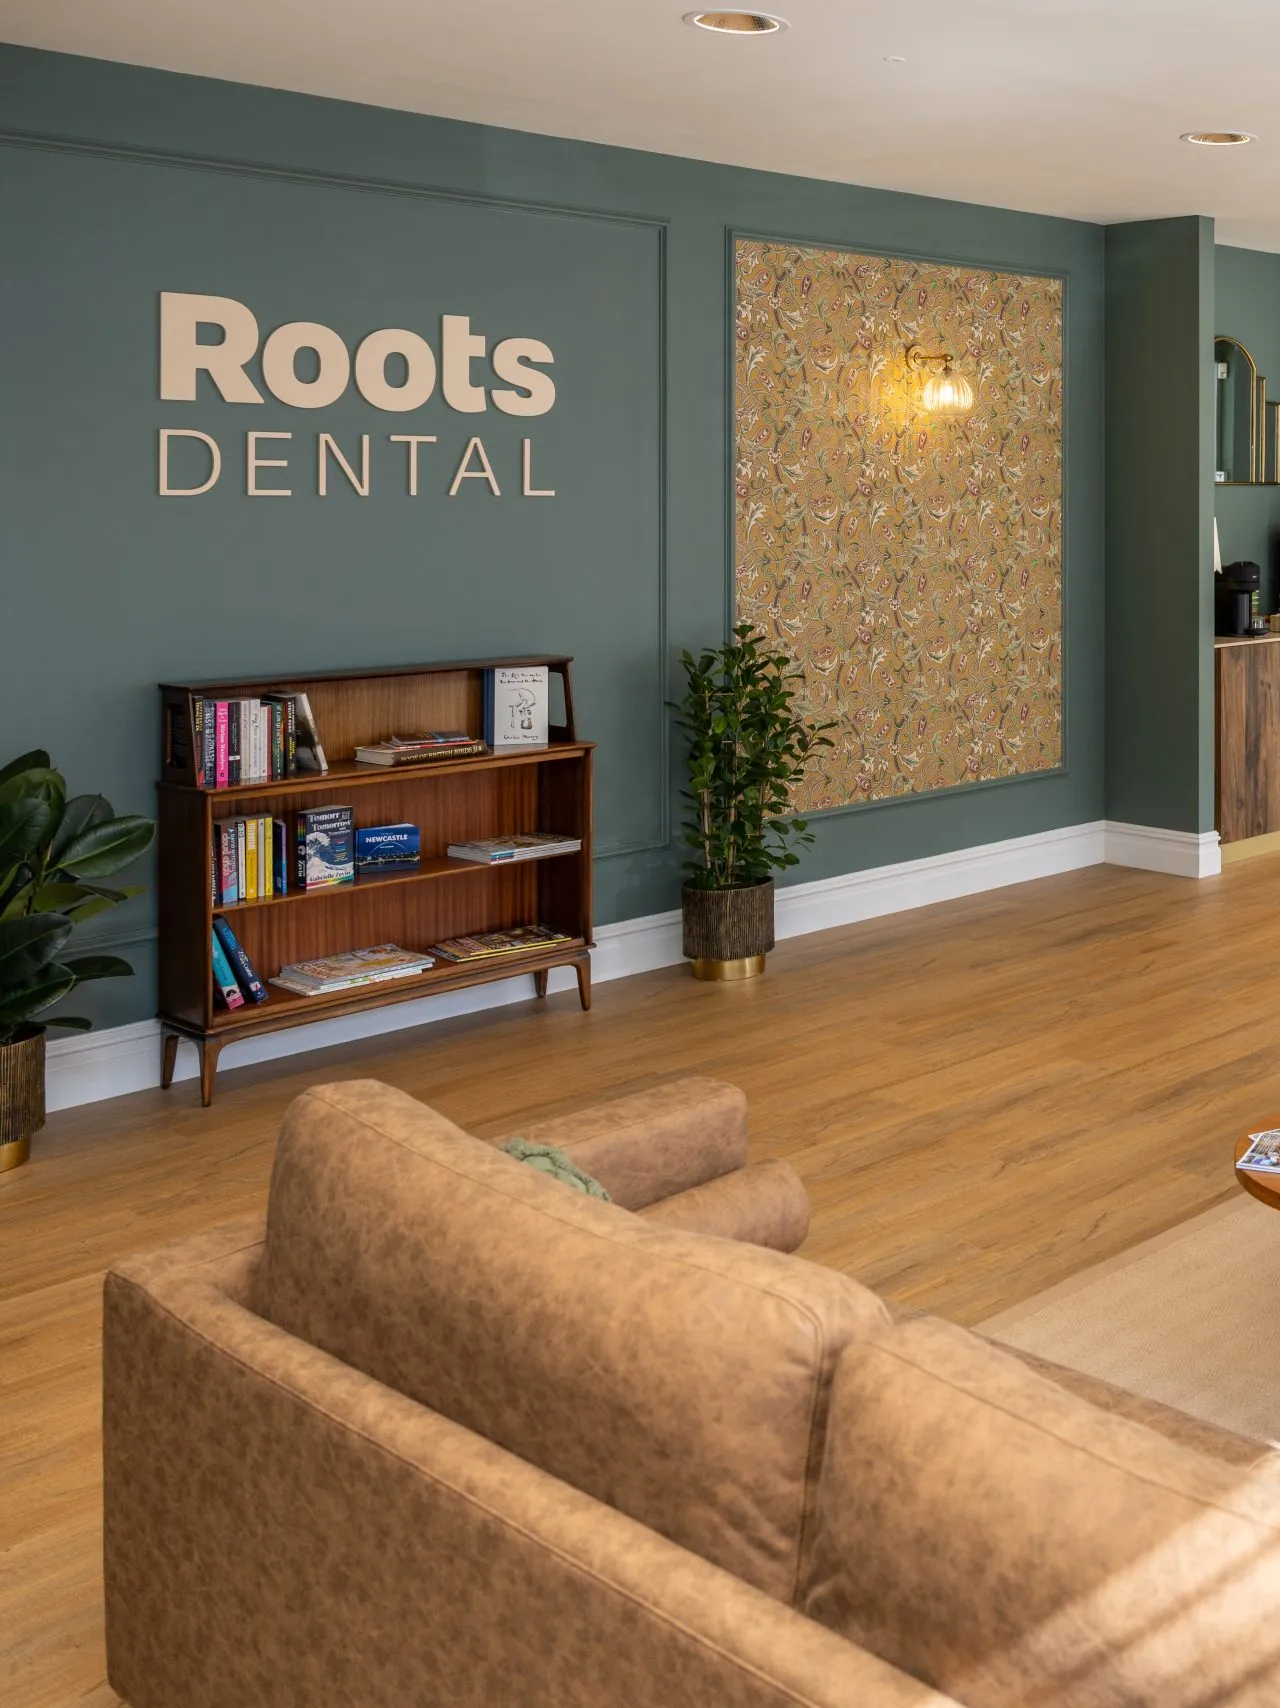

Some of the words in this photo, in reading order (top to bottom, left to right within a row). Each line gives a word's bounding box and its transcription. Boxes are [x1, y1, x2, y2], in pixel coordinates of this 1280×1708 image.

[158, 290, 556, 417] Roots
[157, 428, 556, 496] DENTAL
[454, 746, 473, 755] BIRDS
[308, 812, 341, 822] Tomorr
[312, 819, 352, 831] Tomorrow
[366, 834, 408, 843] NEWCASTLE
